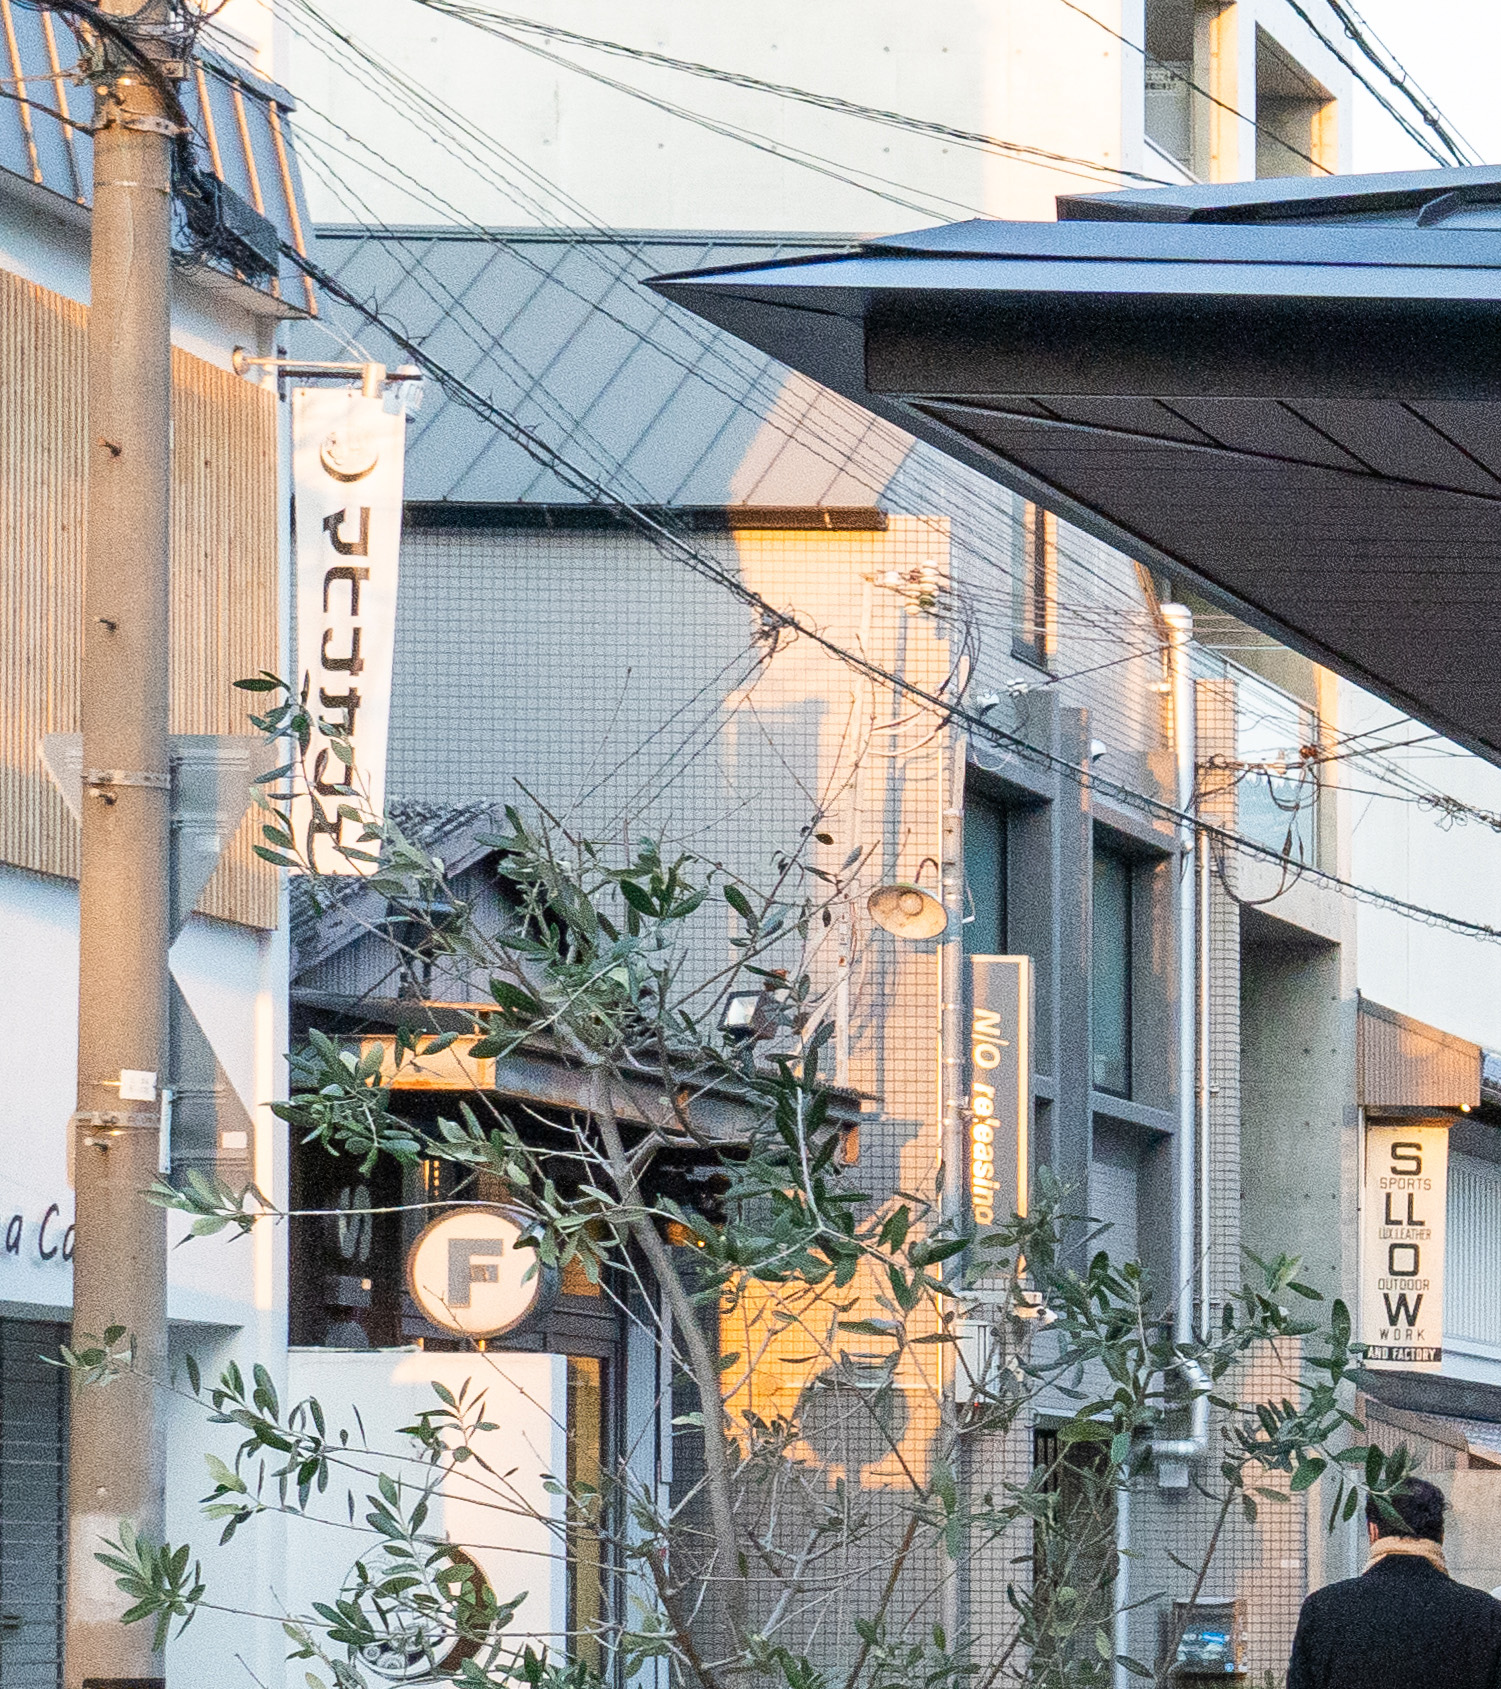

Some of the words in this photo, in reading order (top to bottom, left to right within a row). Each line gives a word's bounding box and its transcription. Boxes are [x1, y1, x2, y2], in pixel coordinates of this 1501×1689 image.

[1380, 1178, 1432, 1191] SPORTS
[448, 1238, 504, 1309] F
[1377, 1278, 1430, 1291] OUTDOOR
[1379, 1329, 1426, 1341] WORK
[1367, 1346, 1388, 1360] AND
[1392, 1347, 1436, 1362] FACTORY
